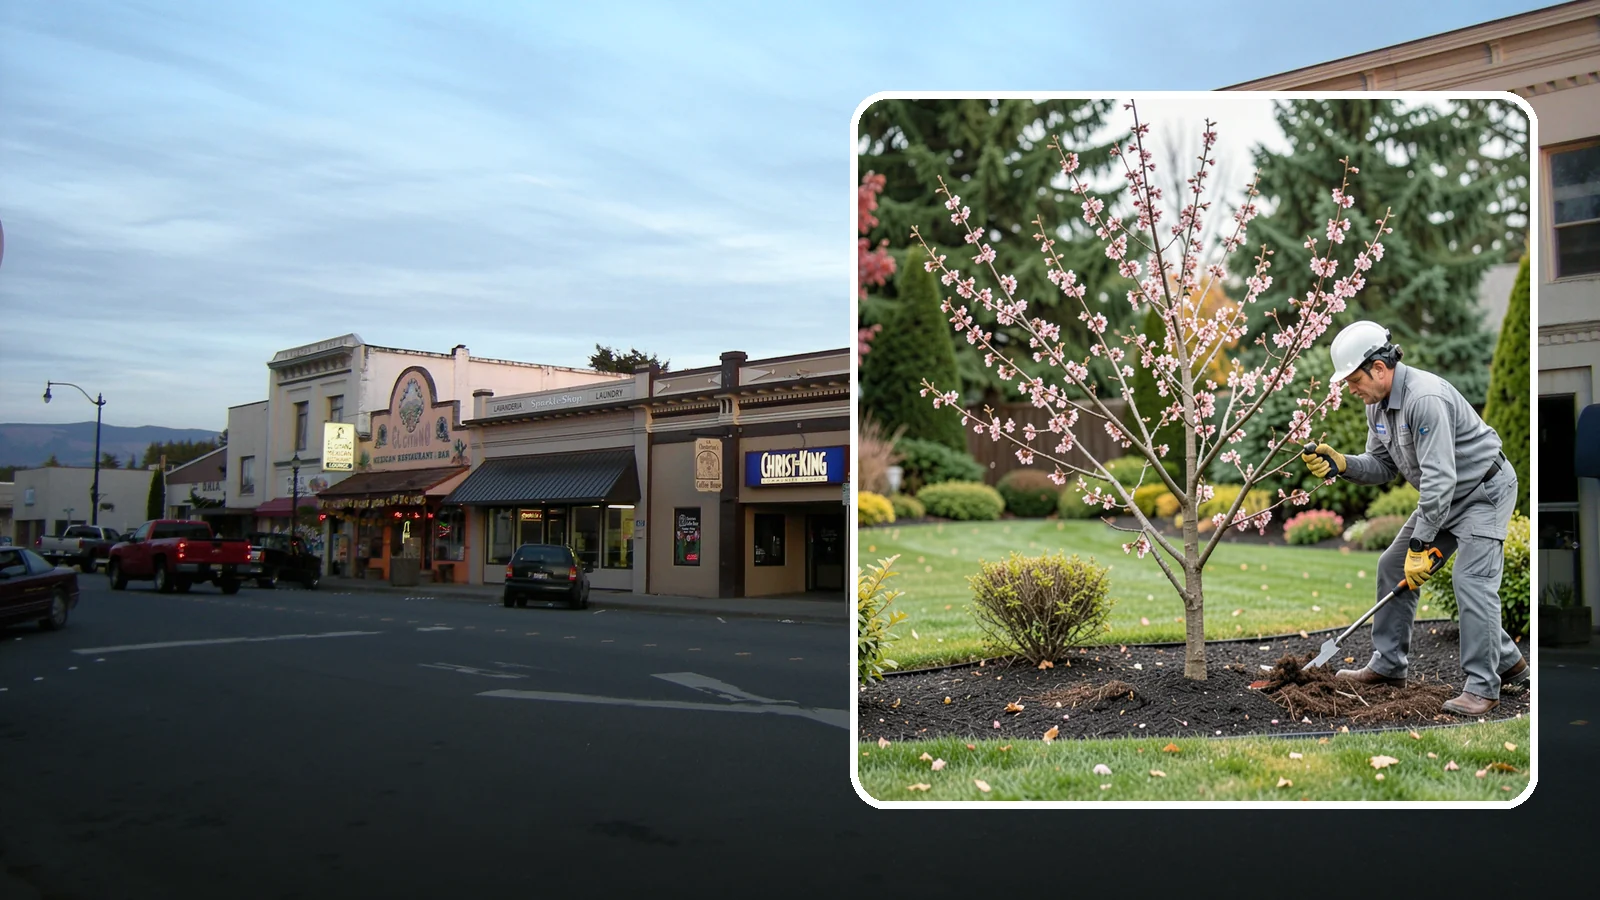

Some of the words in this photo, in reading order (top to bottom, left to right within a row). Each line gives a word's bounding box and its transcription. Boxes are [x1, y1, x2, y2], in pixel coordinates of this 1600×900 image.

[493, 402, 523, 412] LAVANDERIA
[595, 389, 623, 400] LAUNDRY
[373, 455, 396, 464] MEXICAN
[397, 451, 433, 462] RESTAURANT
[438, 450, 450, 459] BAR
[760, 452, 798, 478] CHRIST
[799, 449, 828, 476] KING
